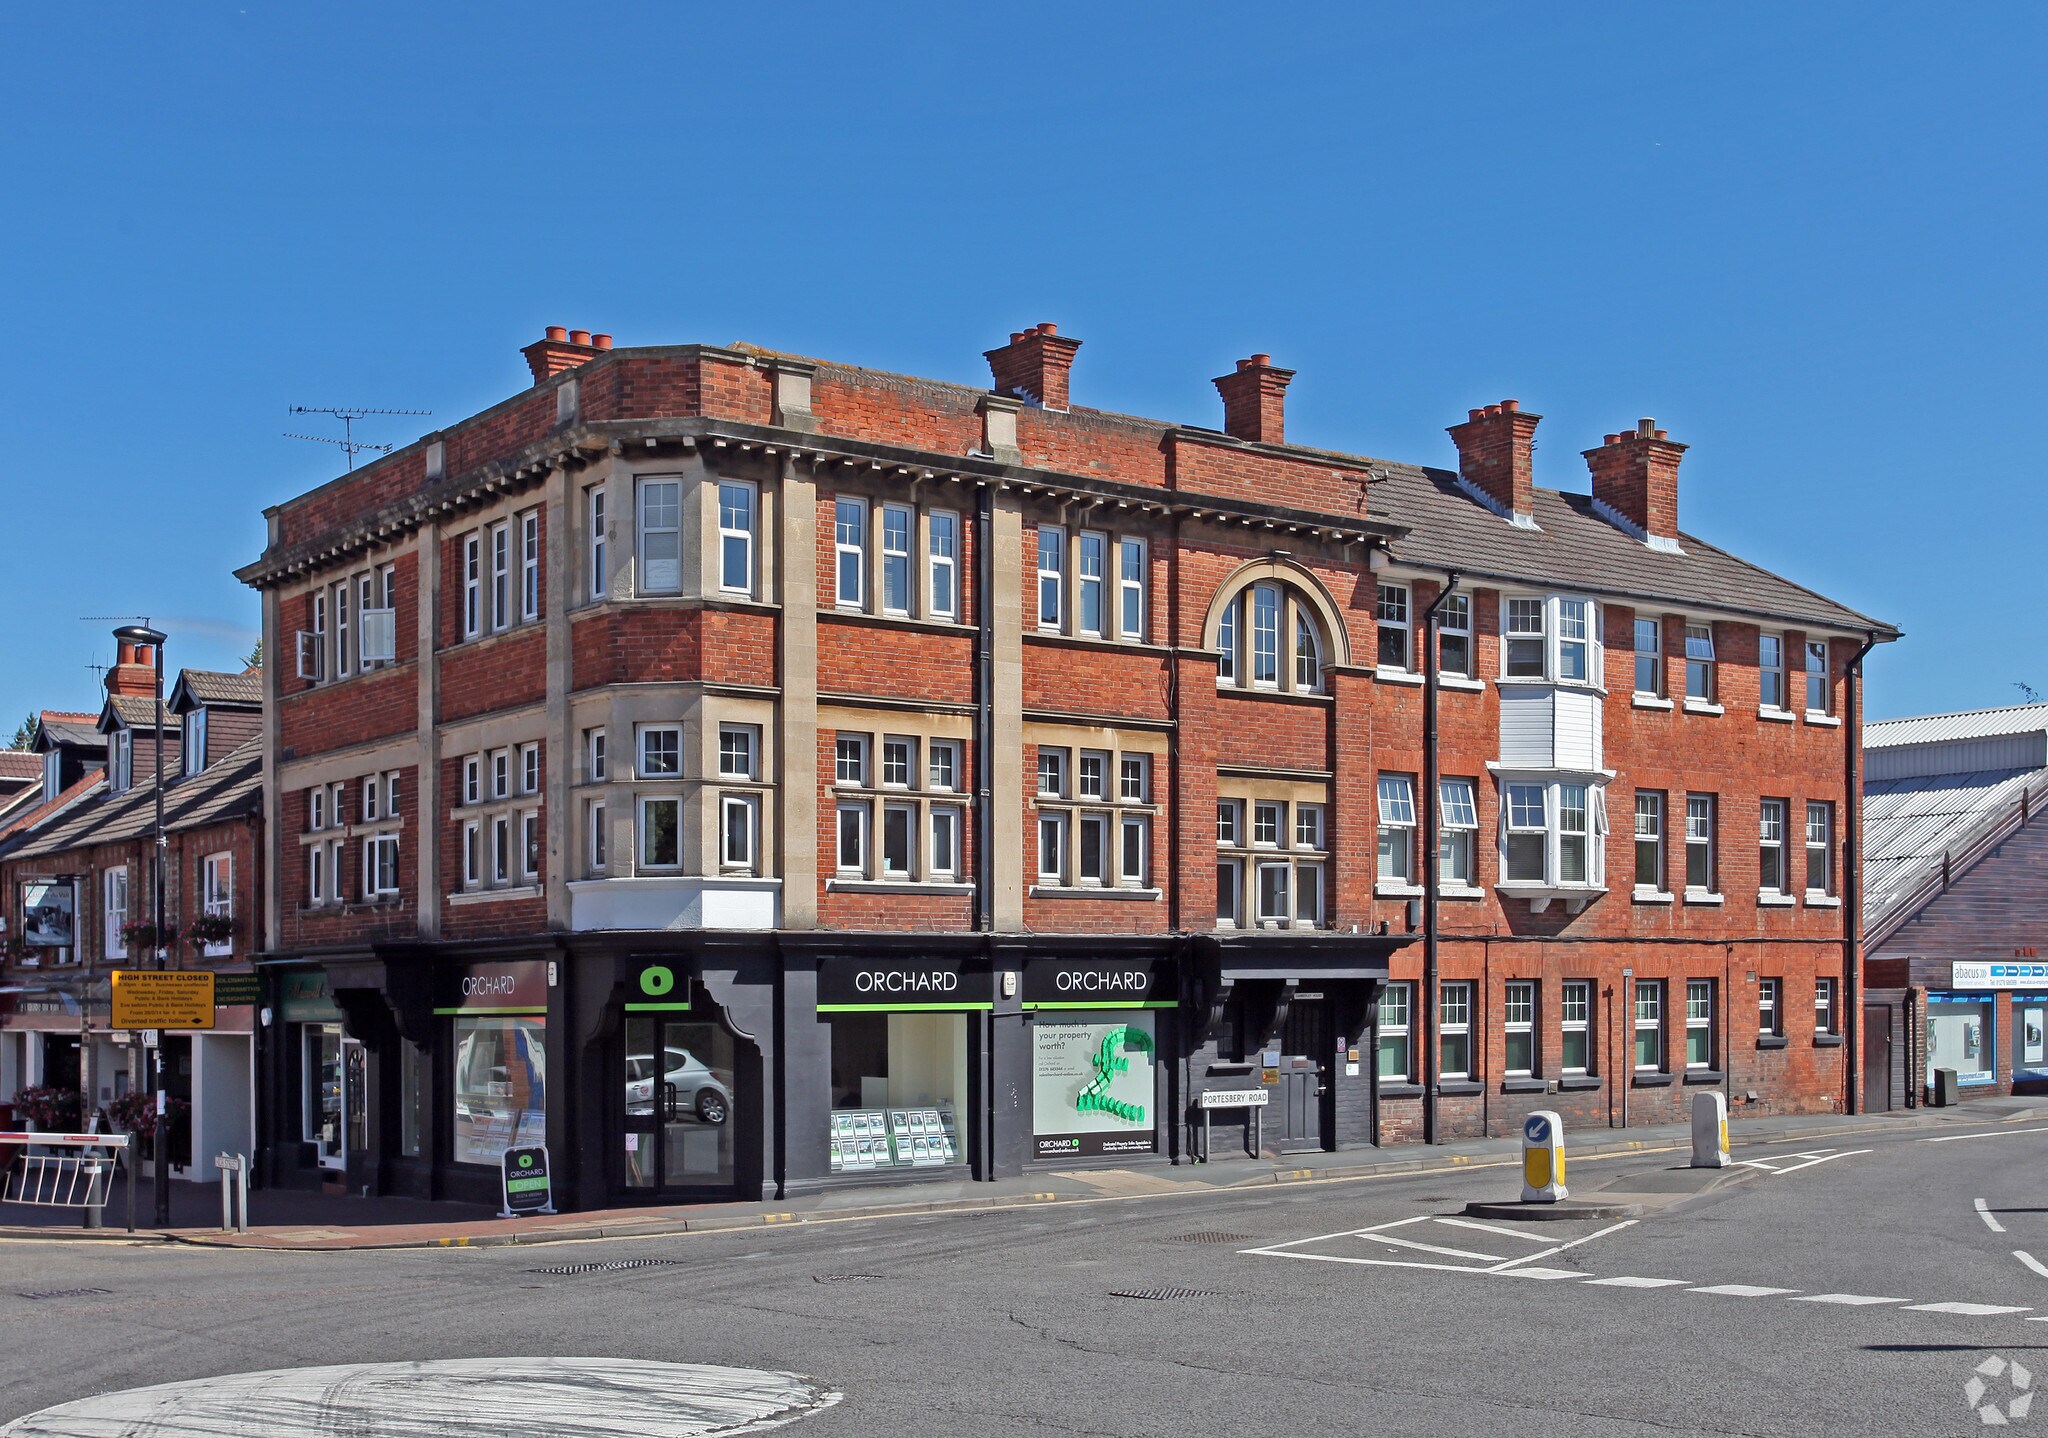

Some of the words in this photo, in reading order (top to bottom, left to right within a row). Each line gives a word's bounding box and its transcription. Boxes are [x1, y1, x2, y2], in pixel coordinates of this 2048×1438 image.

[1954, 964, 1980, 978] abacus
[462, 976, 515, 995] ORCHARD
[856, 972, 958, 992] ORCHARD
[1056, 972, 1146, 990] ORCHARD
[1040, 1020, 1056, 1028] How
[1059, 1020, 1080, 1028] much
[1082, 1020, 1088, 1028] is
[1059, 1031, 1092, 1040] property
[1039, 1042, 1066, 1050] worth?
[1204, 1094, 1245, 1103] PORTESBERY
[1249, 1093, 1267, 1102] ROAD
[1039, 1140, 1071, 1148] ORCHARD
[510, 1169, 543, 1178] ORCHARD
[516, 1180, 541, 1189] OPEN
